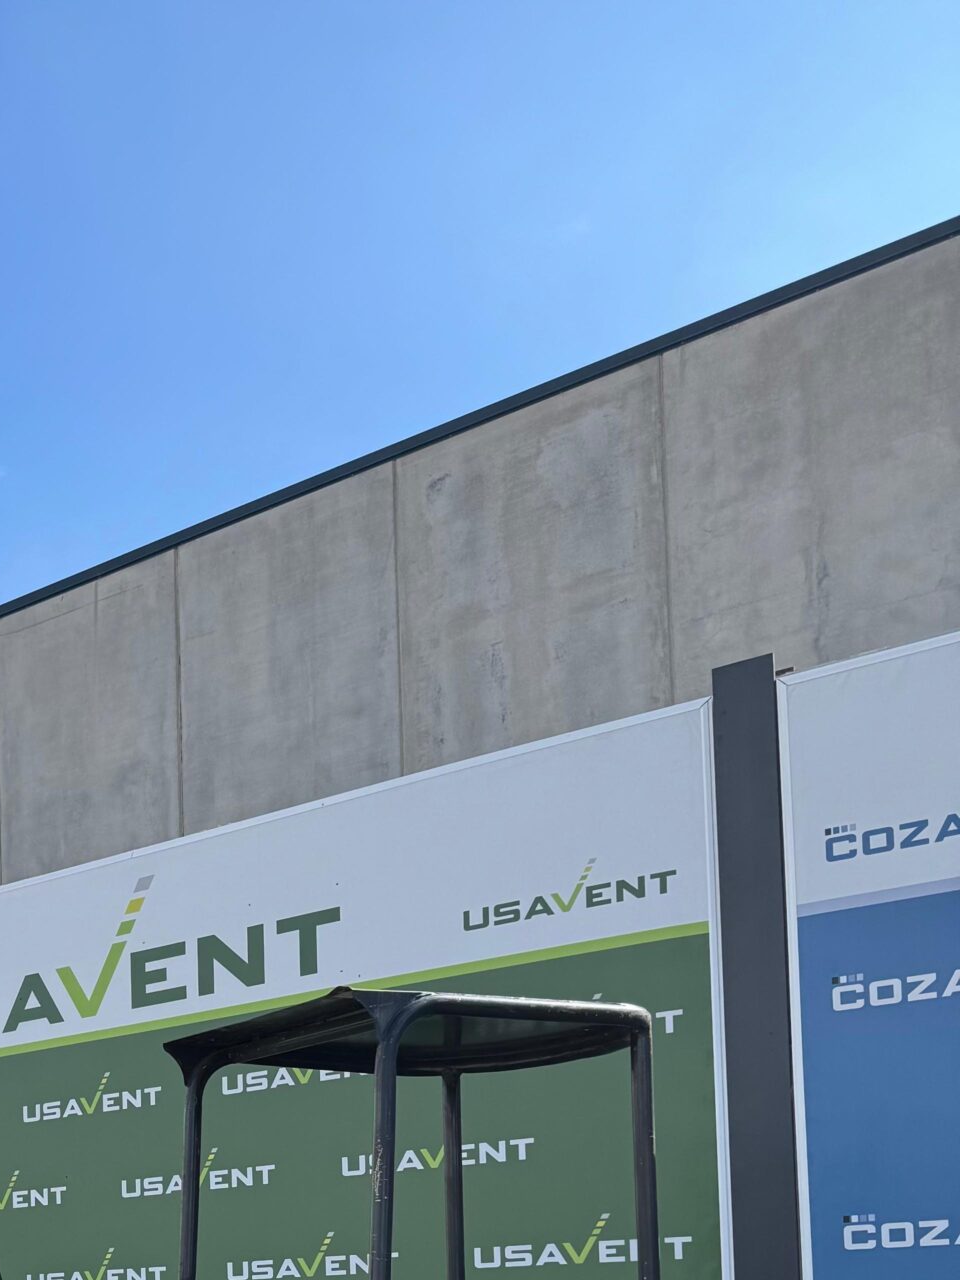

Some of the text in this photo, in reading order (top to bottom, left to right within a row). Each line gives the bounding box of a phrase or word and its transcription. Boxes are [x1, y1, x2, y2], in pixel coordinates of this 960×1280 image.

[463, 869, 677, 931] USAVENT
[23, 1086, 162, 1123] USAVENT
[341, 1138, 535, 1177] UAVENT
[843, 1219, 960, 1250] COZ
[226, 1252, 399, 1280] USAVEN
